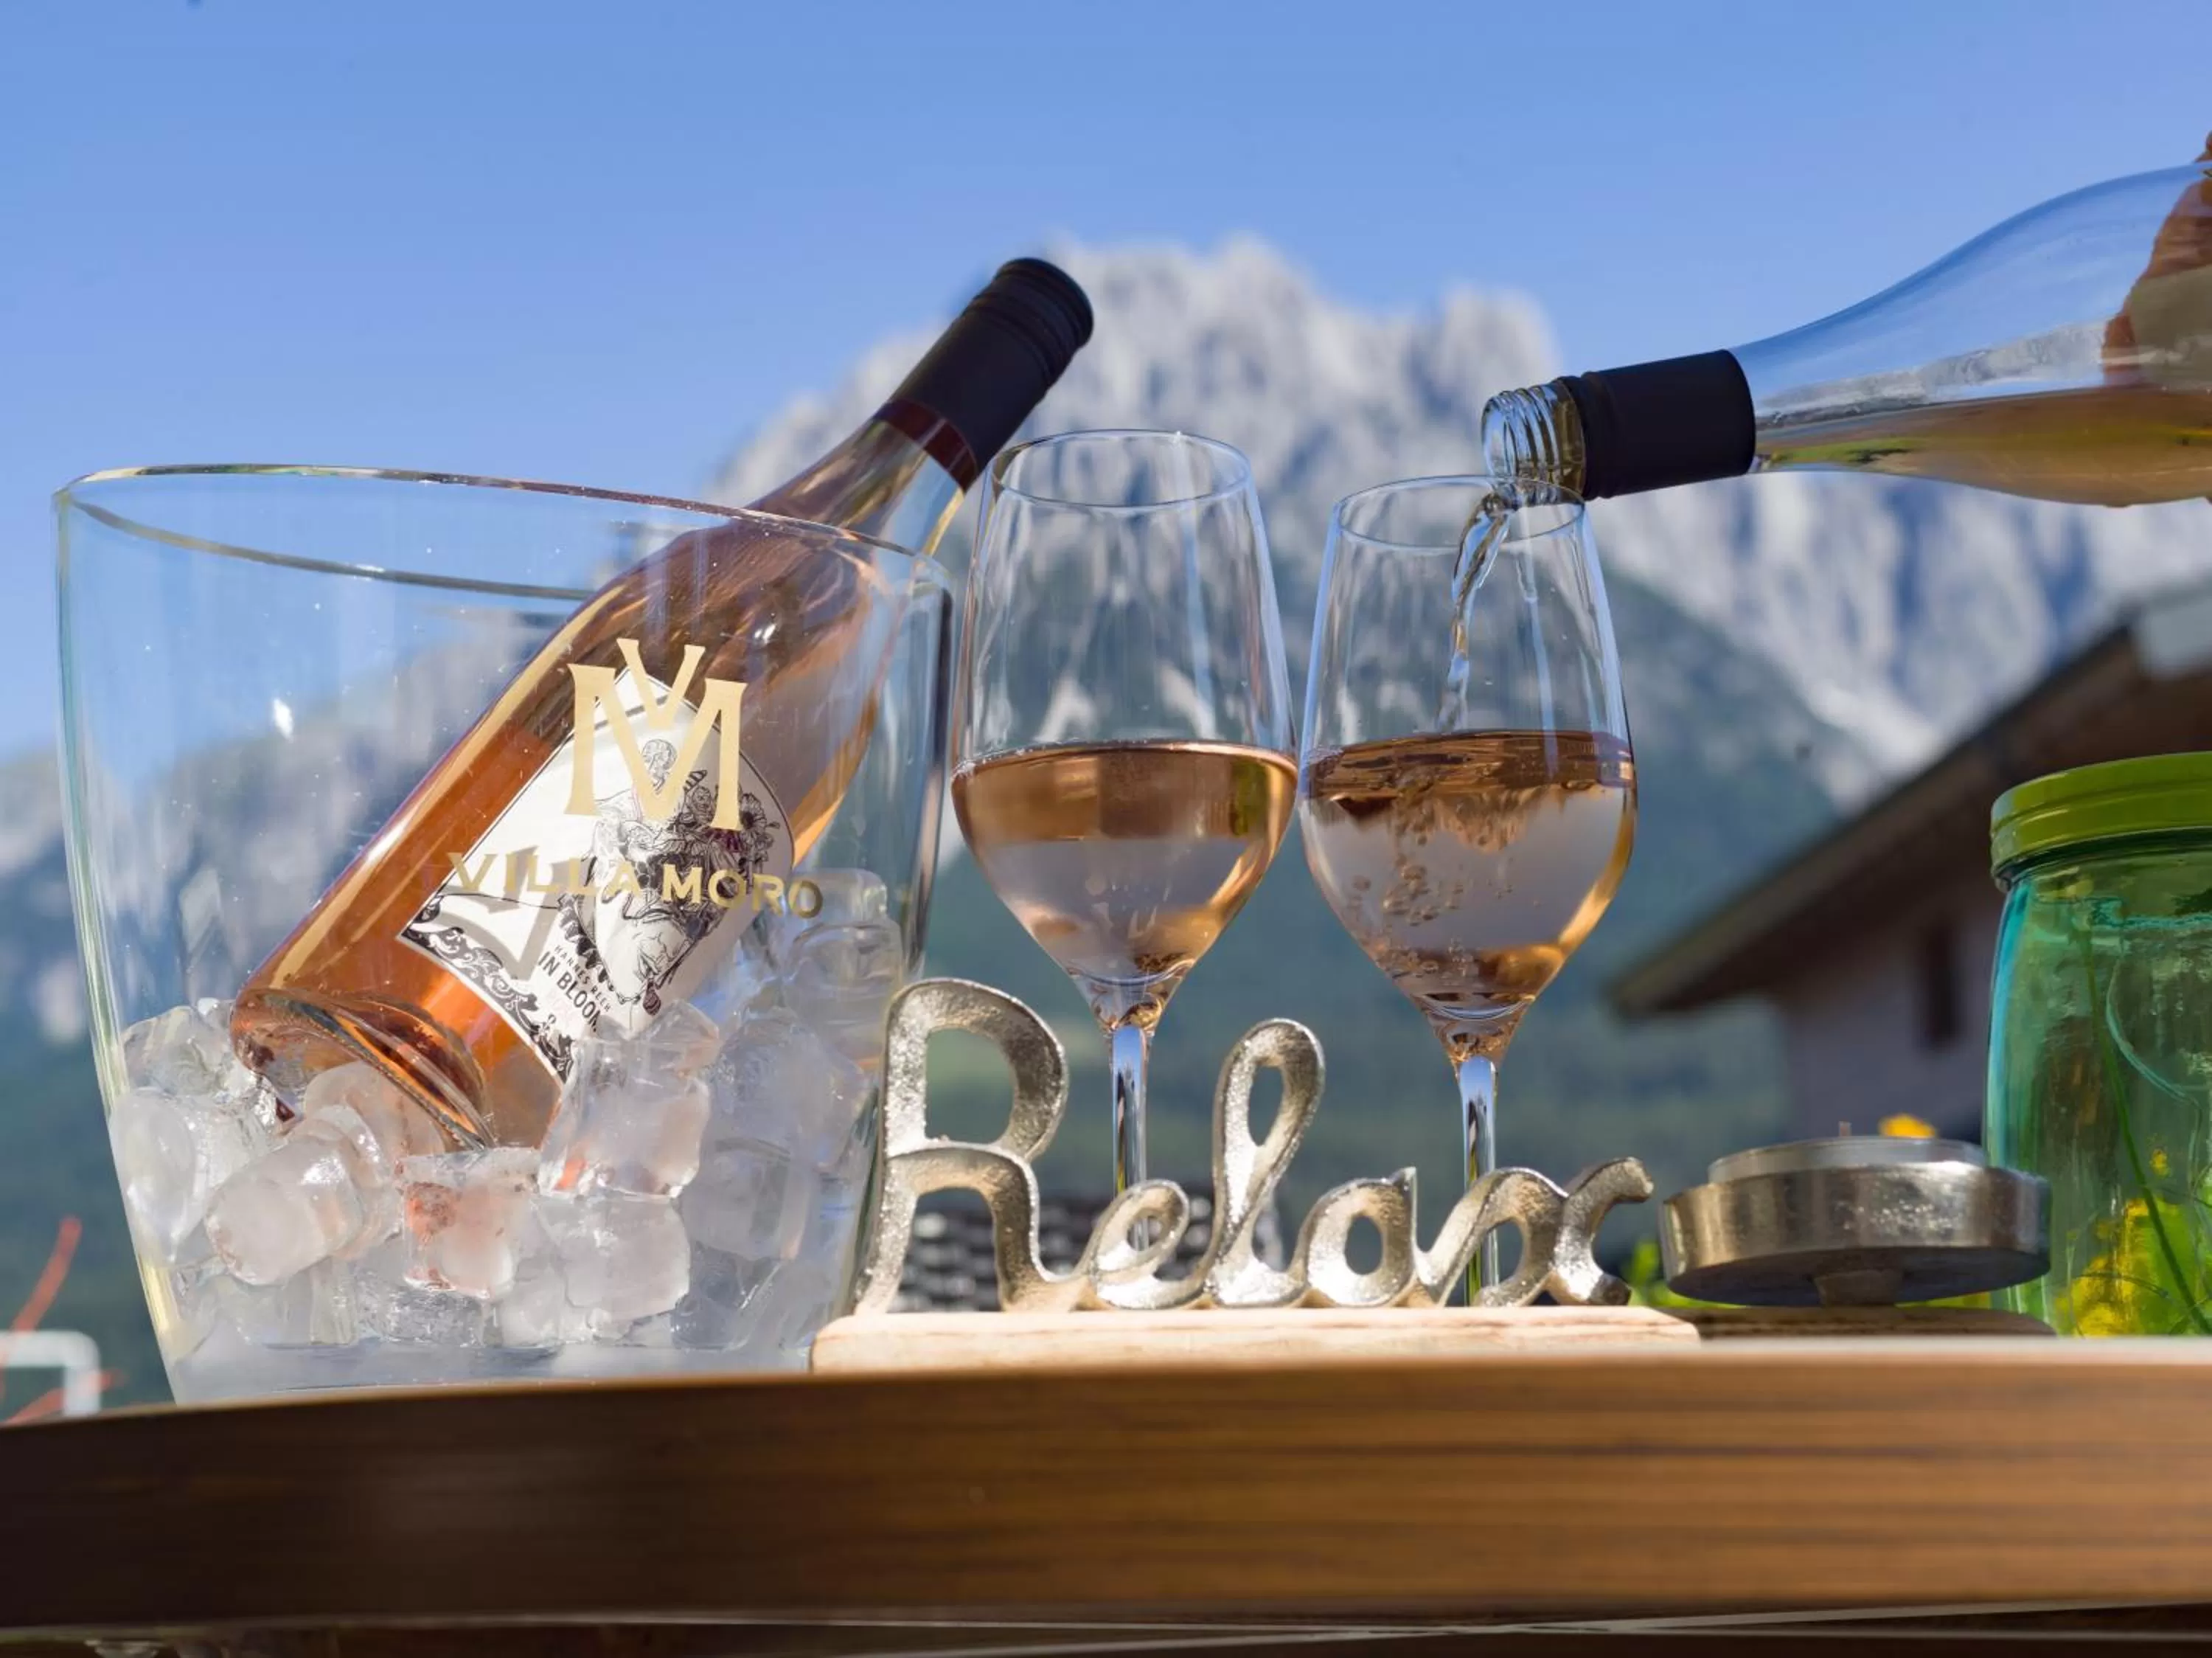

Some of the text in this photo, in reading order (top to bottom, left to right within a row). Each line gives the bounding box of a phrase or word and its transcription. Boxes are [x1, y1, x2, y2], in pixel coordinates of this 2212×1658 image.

[447, 851, 824, 919] VILLA MORO
[538, 951, 560, 977] IN
[852, 977, 1654, 1313] Relax
